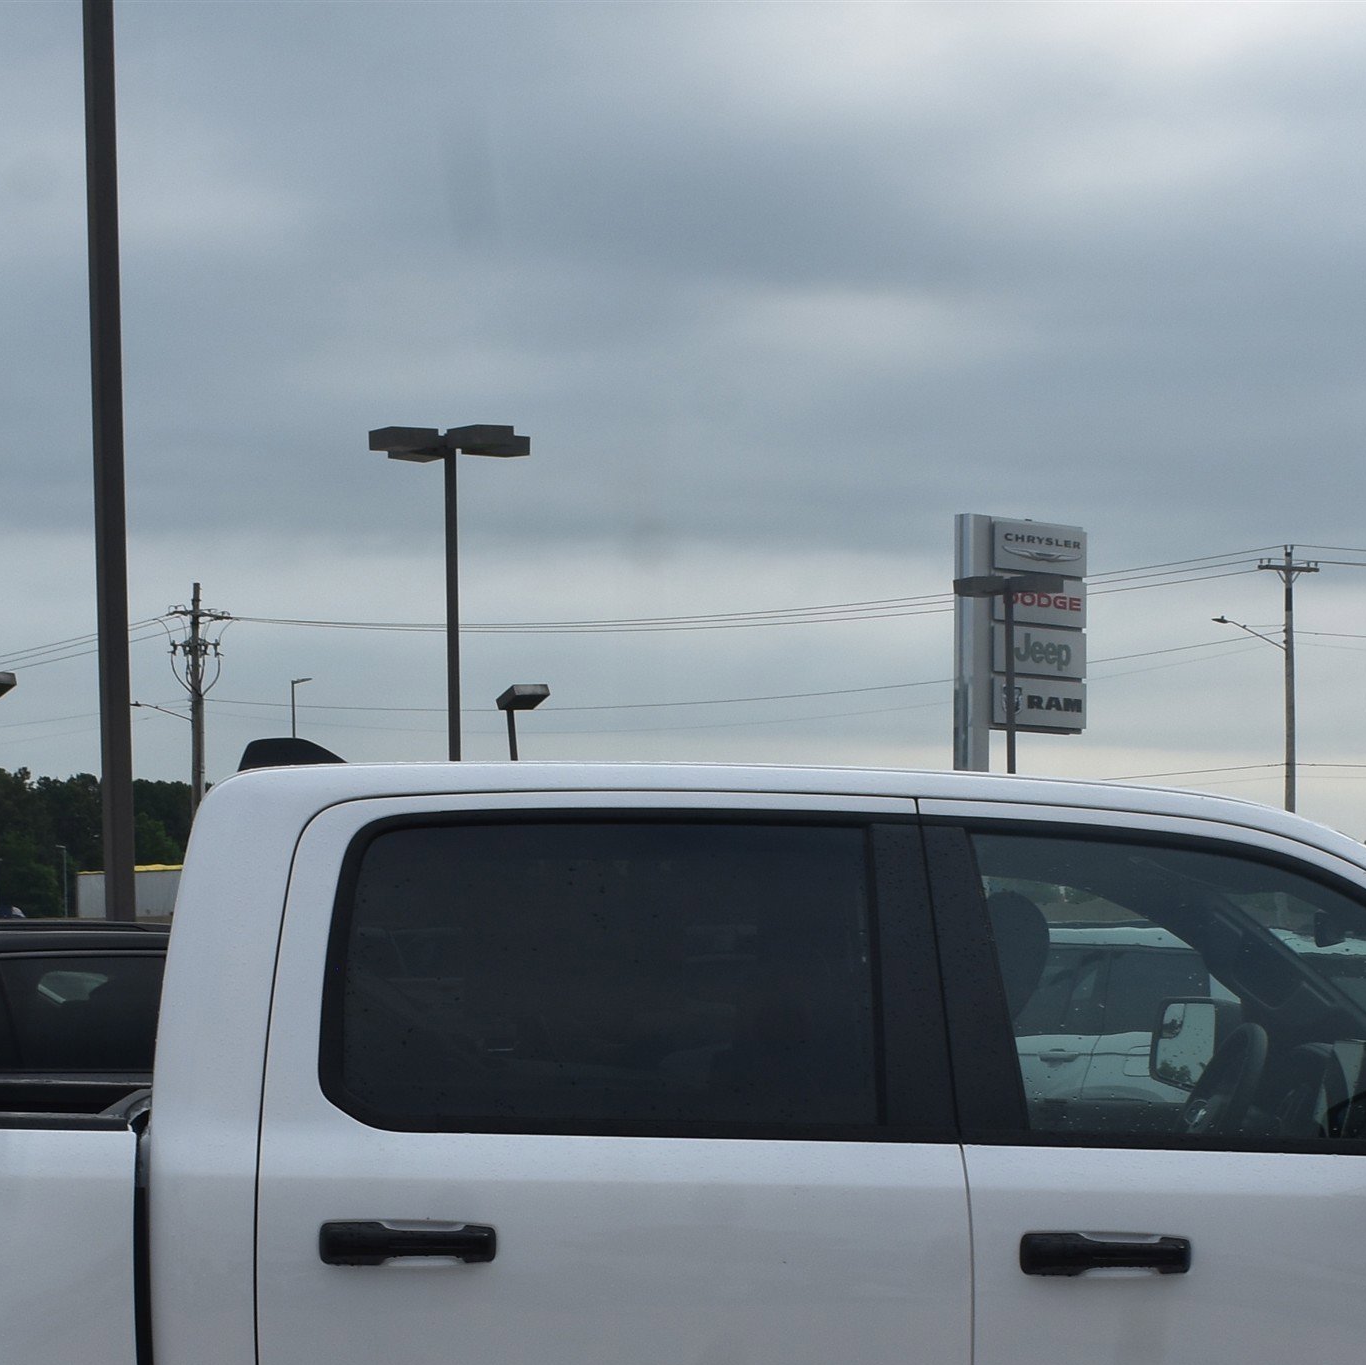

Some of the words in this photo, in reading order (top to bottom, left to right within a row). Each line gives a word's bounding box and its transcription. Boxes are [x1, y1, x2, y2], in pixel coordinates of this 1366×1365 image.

[1004, 532, 1081, 550] CHRYSLER
[1014, 633, 1072, 671] Jeep
[1027, 695, 1083, 713] RAM
